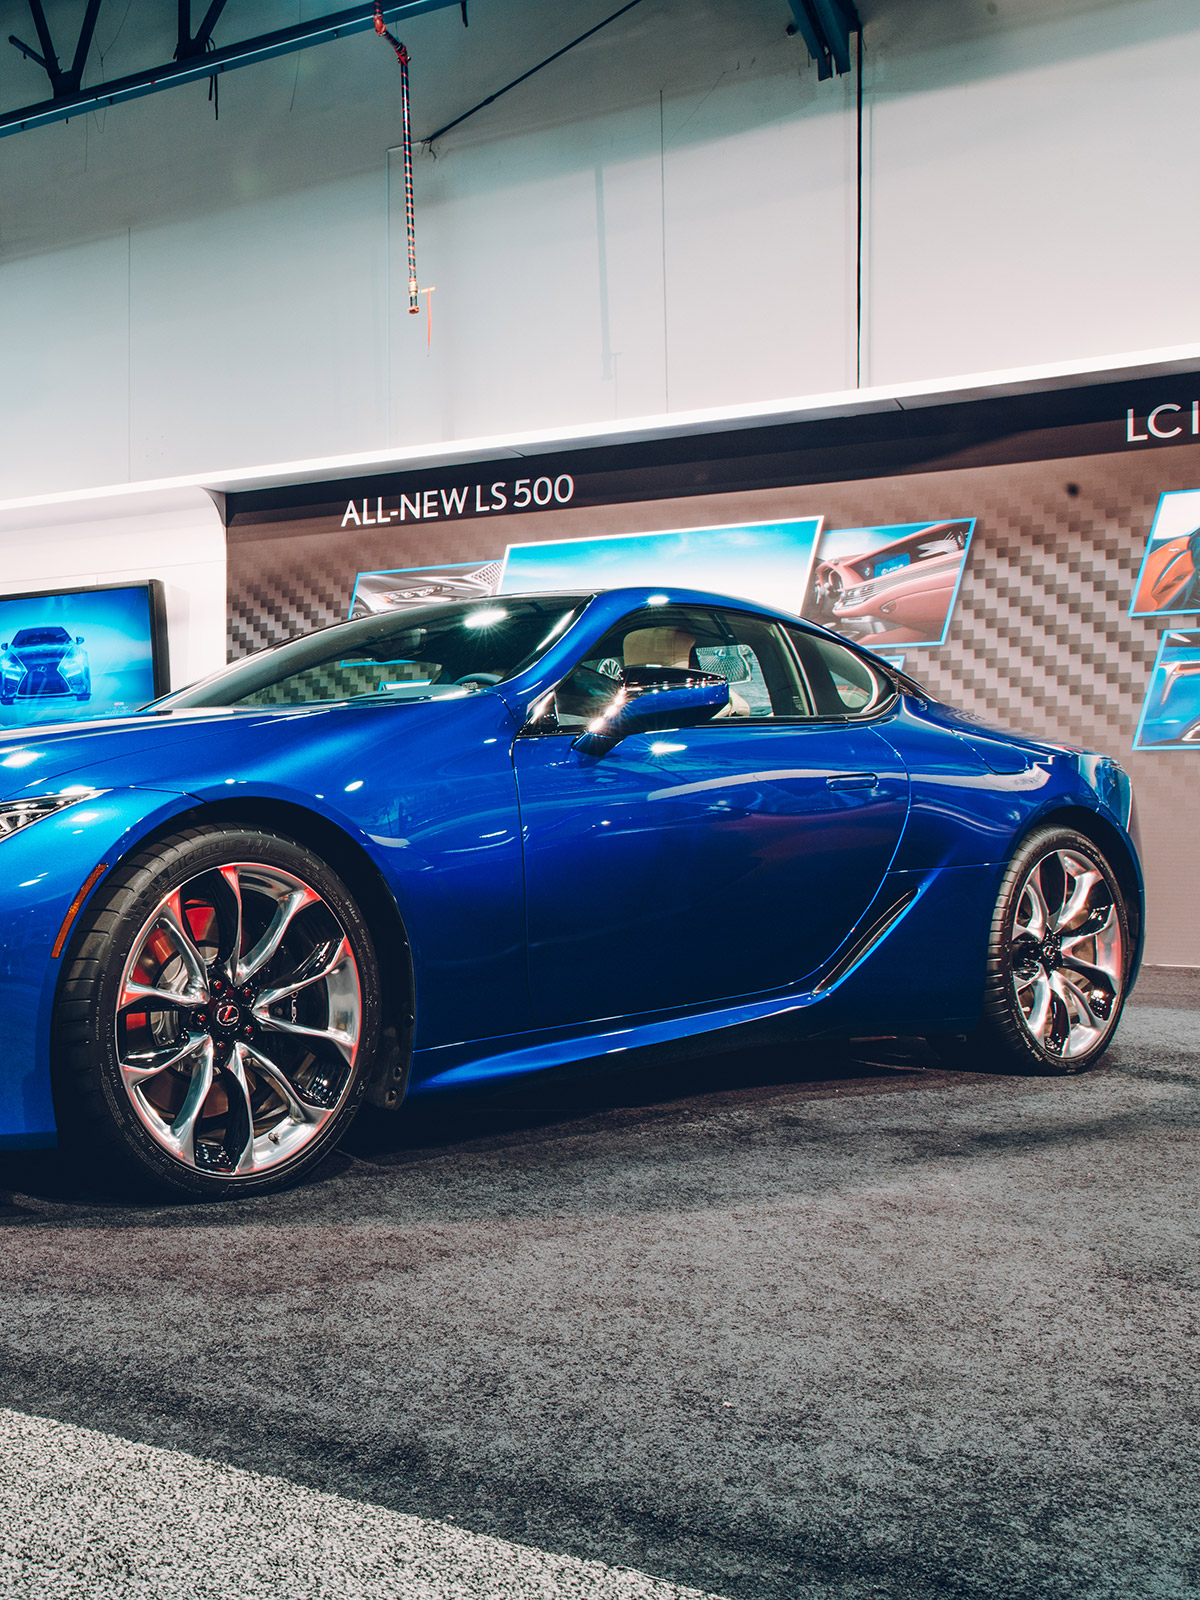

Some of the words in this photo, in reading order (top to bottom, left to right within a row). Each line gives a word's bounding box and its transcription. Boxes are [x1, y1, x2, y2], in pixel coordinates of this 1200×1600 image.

[1127, 403, 1183, 442] LC
[340, 486, 469, 528] ALL-NEW
[475, 481, 507, 513] LS
[513, 474, 574, 509] 500
